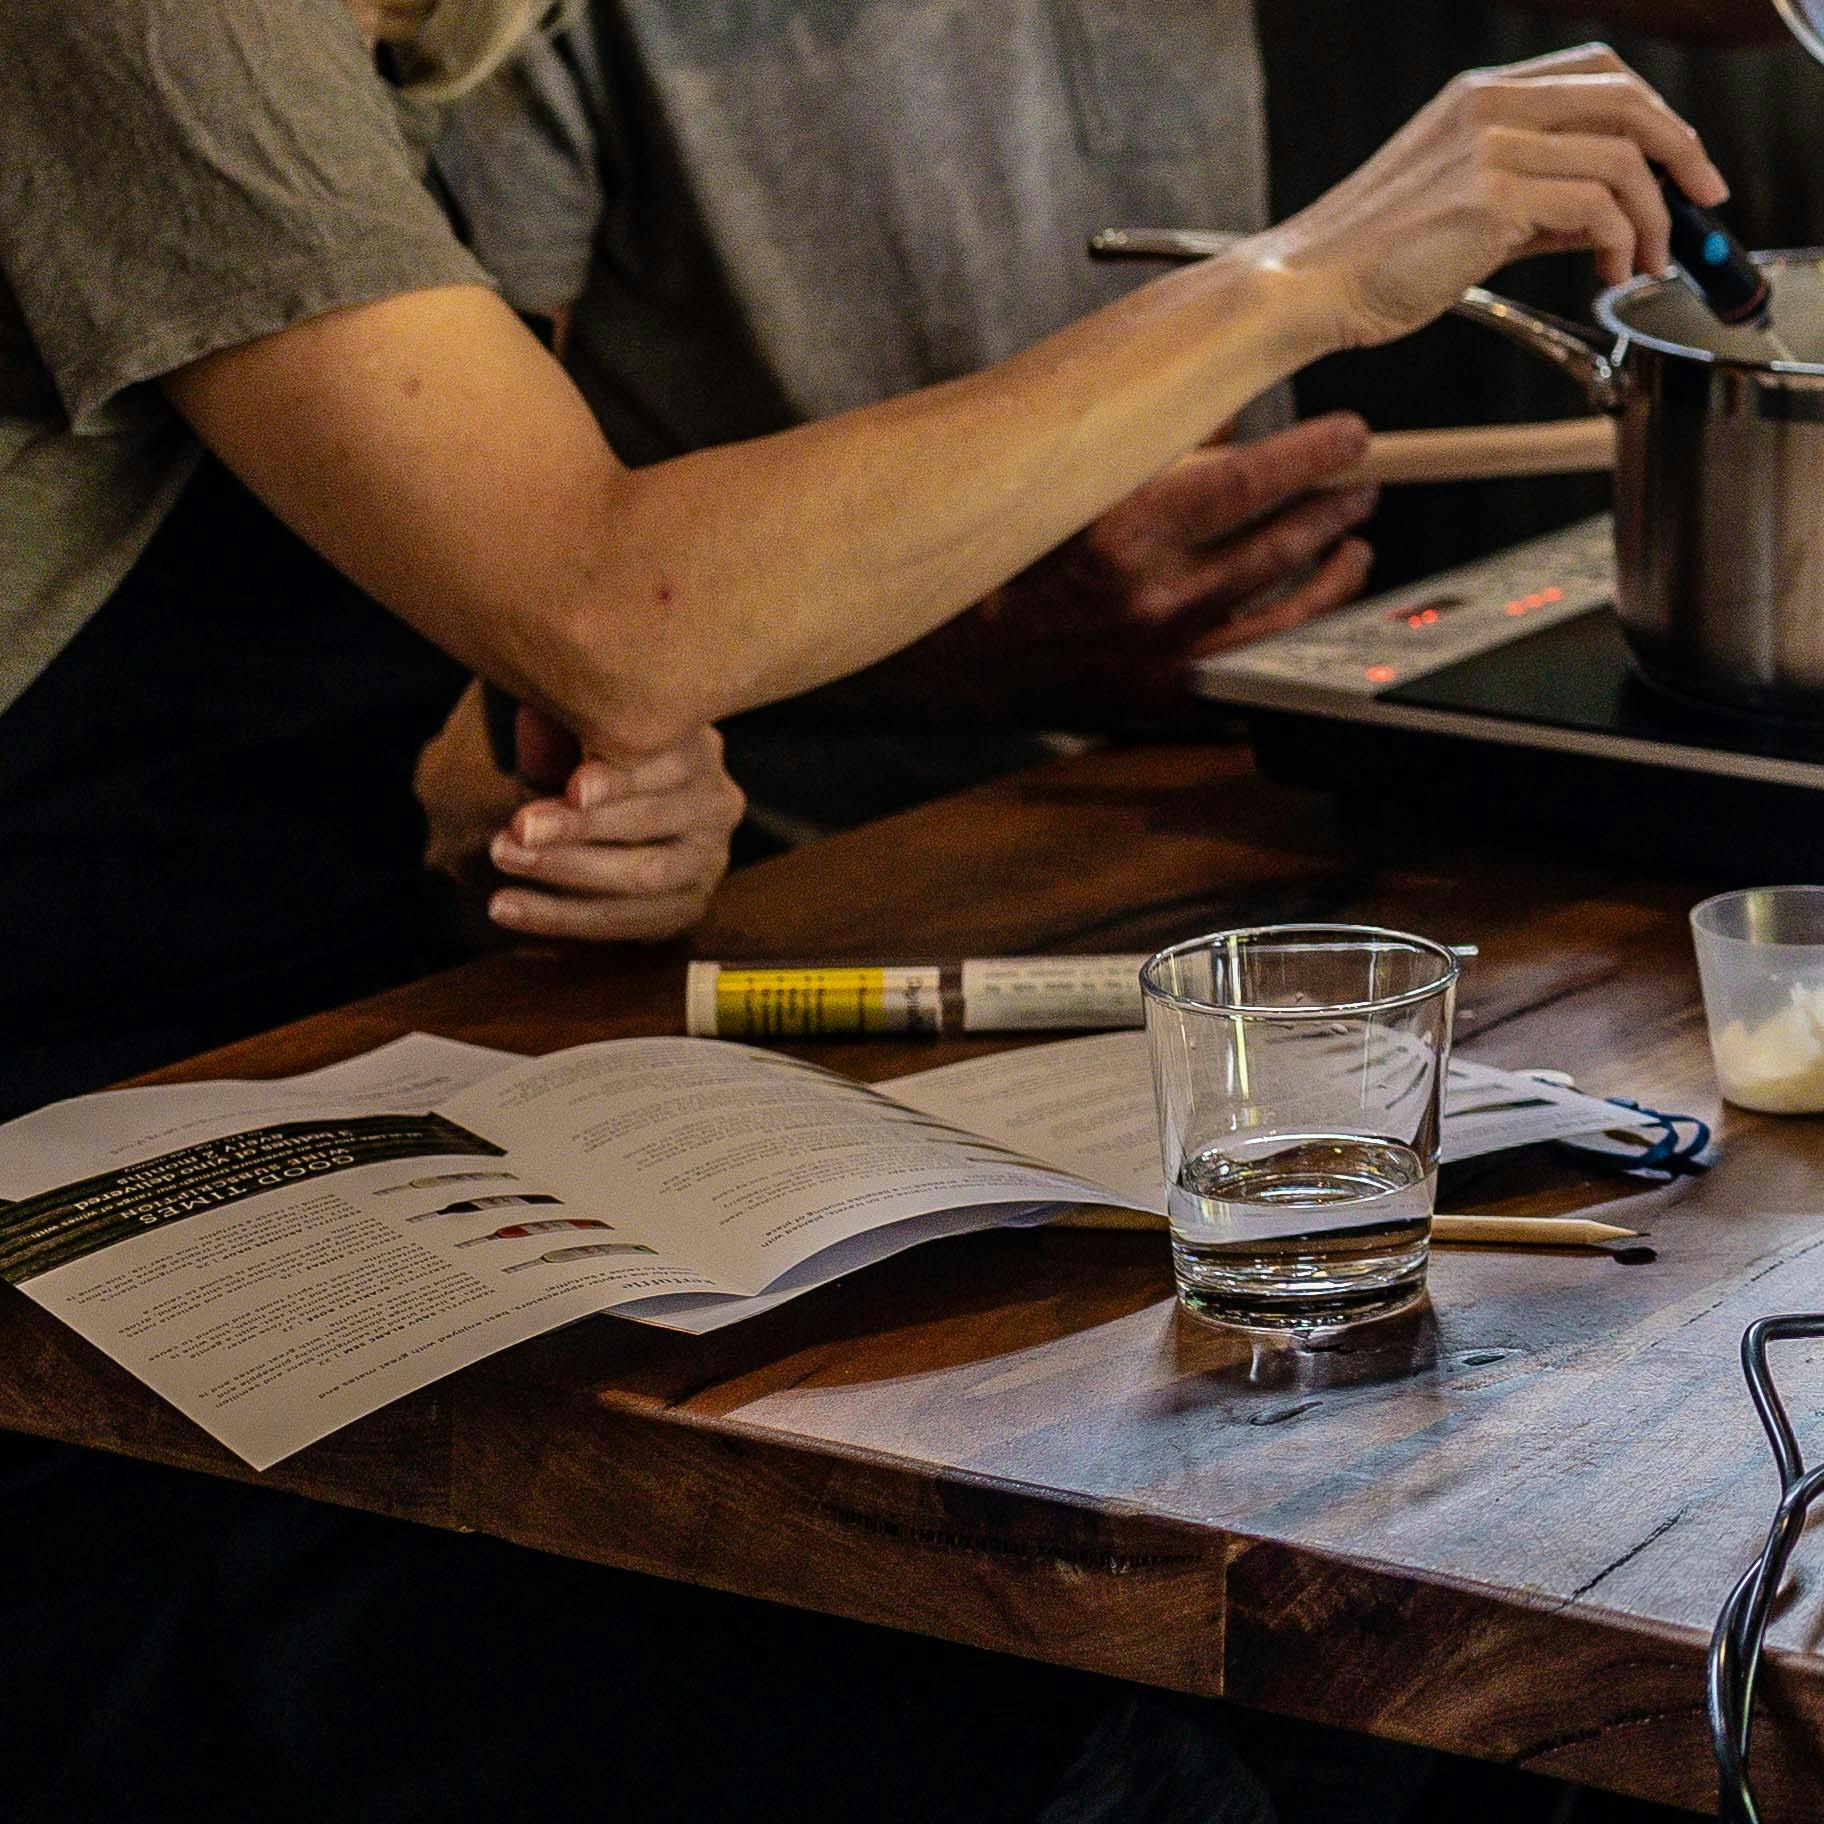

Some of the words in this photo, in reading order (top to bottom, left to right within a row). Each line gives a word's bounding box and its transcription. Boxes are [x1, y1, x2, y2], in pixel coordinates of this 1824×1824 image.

[257, 1155, 355, 1185] GOOD
[73, 1172, 176, 1211] delivered
[119, 1161, 281, 1219] SUBSCRIPTION
[138, 1183, 248, 1225] TIMES
[230, 1311, 254, 1323] and
[405, 1311, 438, 1326] SAUV
[232, 1324, 260, 1338] with
[366, 1324, 407, 1343] BLANC
[341, 1341, 367, 1354] SEM
[410, 1341, 438, 1355] with
[377, 1352, 411, 1369] great
[261, 1371, 286, 1385] and
[340, 1367, 379, 1386] mates
[214, 1386, 239, 1399] and
[315, 1385, 342, 1399] and
